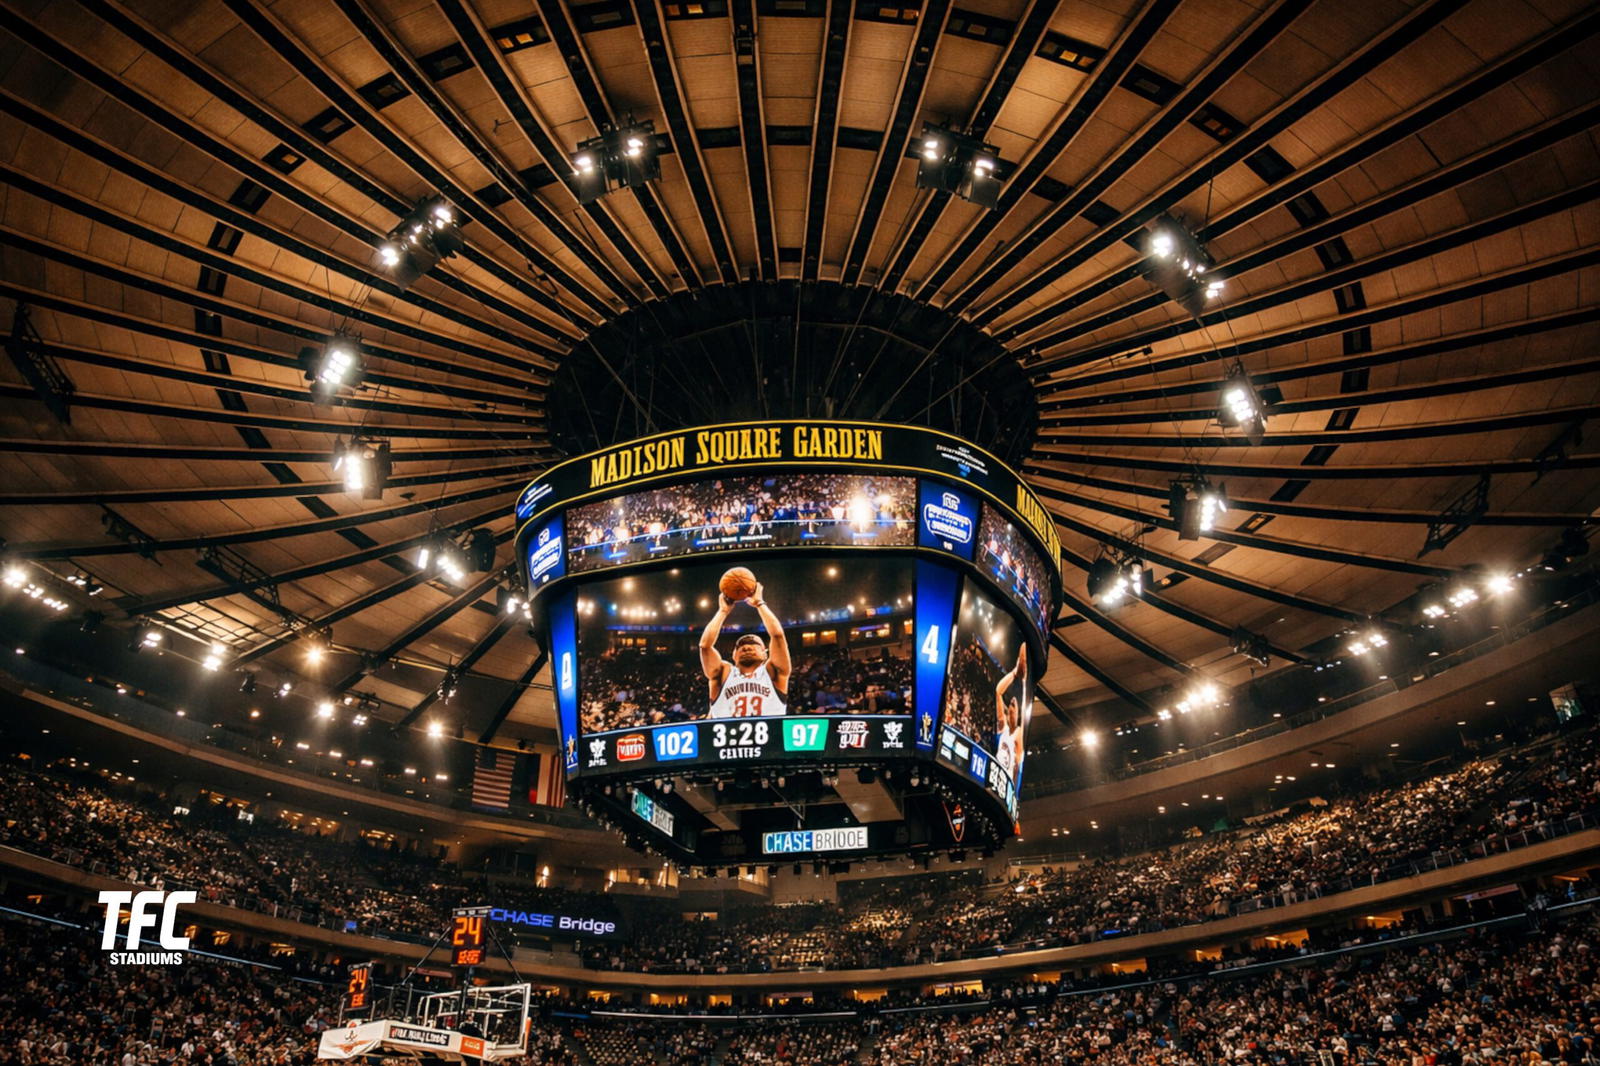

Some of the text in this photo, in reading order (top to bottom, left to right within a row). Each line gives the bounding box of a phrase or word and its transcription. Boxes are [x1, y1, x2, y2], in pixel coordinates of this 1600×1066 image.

[590, 426, 883, 488] MADISON SQUARE GARDEN
[921, 624, 939, 664] 4
[657, 730, 694, 756] 102
[713, 721, 769, 747] 3:28
[792, 724, 820, 747] 97
[765, 832, 812, 854] CHASE
[453, 916, 482, 945] 24
[489, 908, 616, 934] CHASE Bridge
[349, 967, 368, 993] 24
